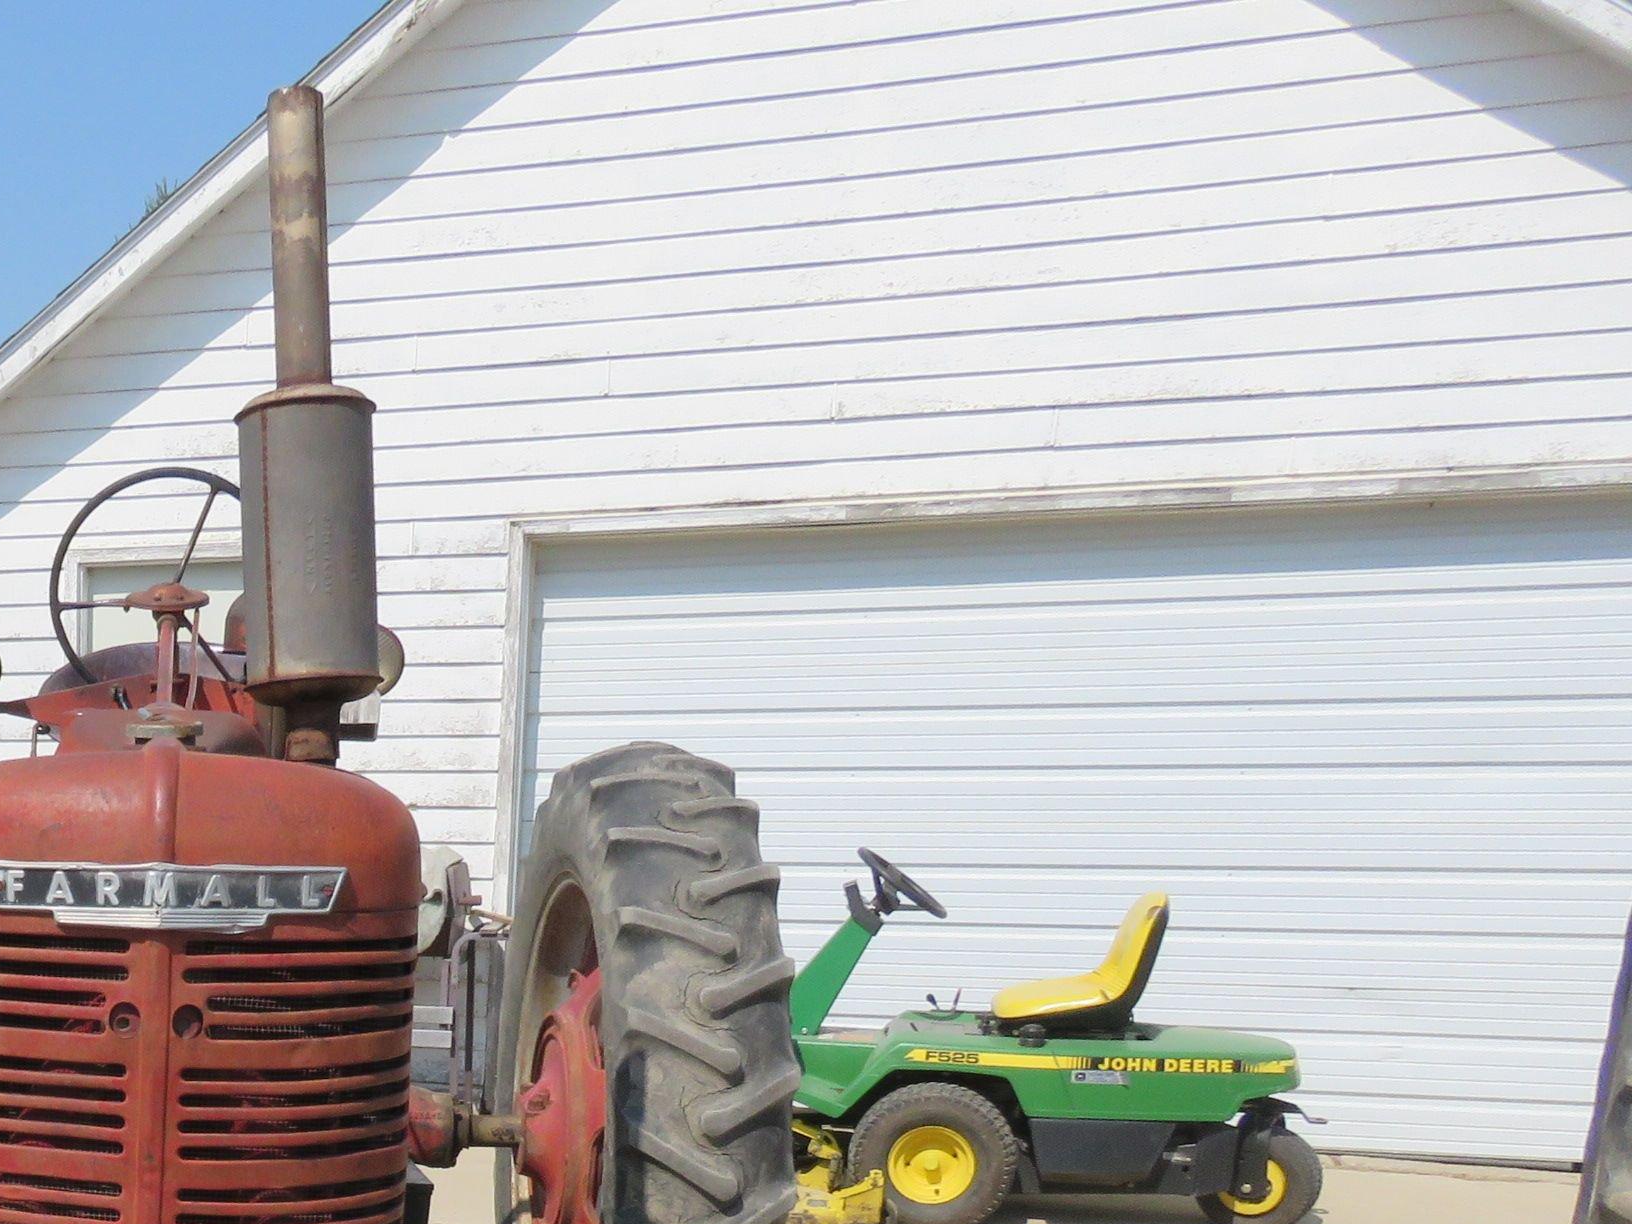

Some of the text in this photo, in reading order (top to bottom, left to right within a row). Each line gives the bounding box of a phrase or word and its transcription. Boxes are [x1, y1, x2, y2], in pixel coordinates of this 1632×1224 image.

[5, 868, 322, 908] FARMALL
[925, 1051, 980, 1064] F525
[1097, 1057, 1235, 1073] JOHN DEERE
